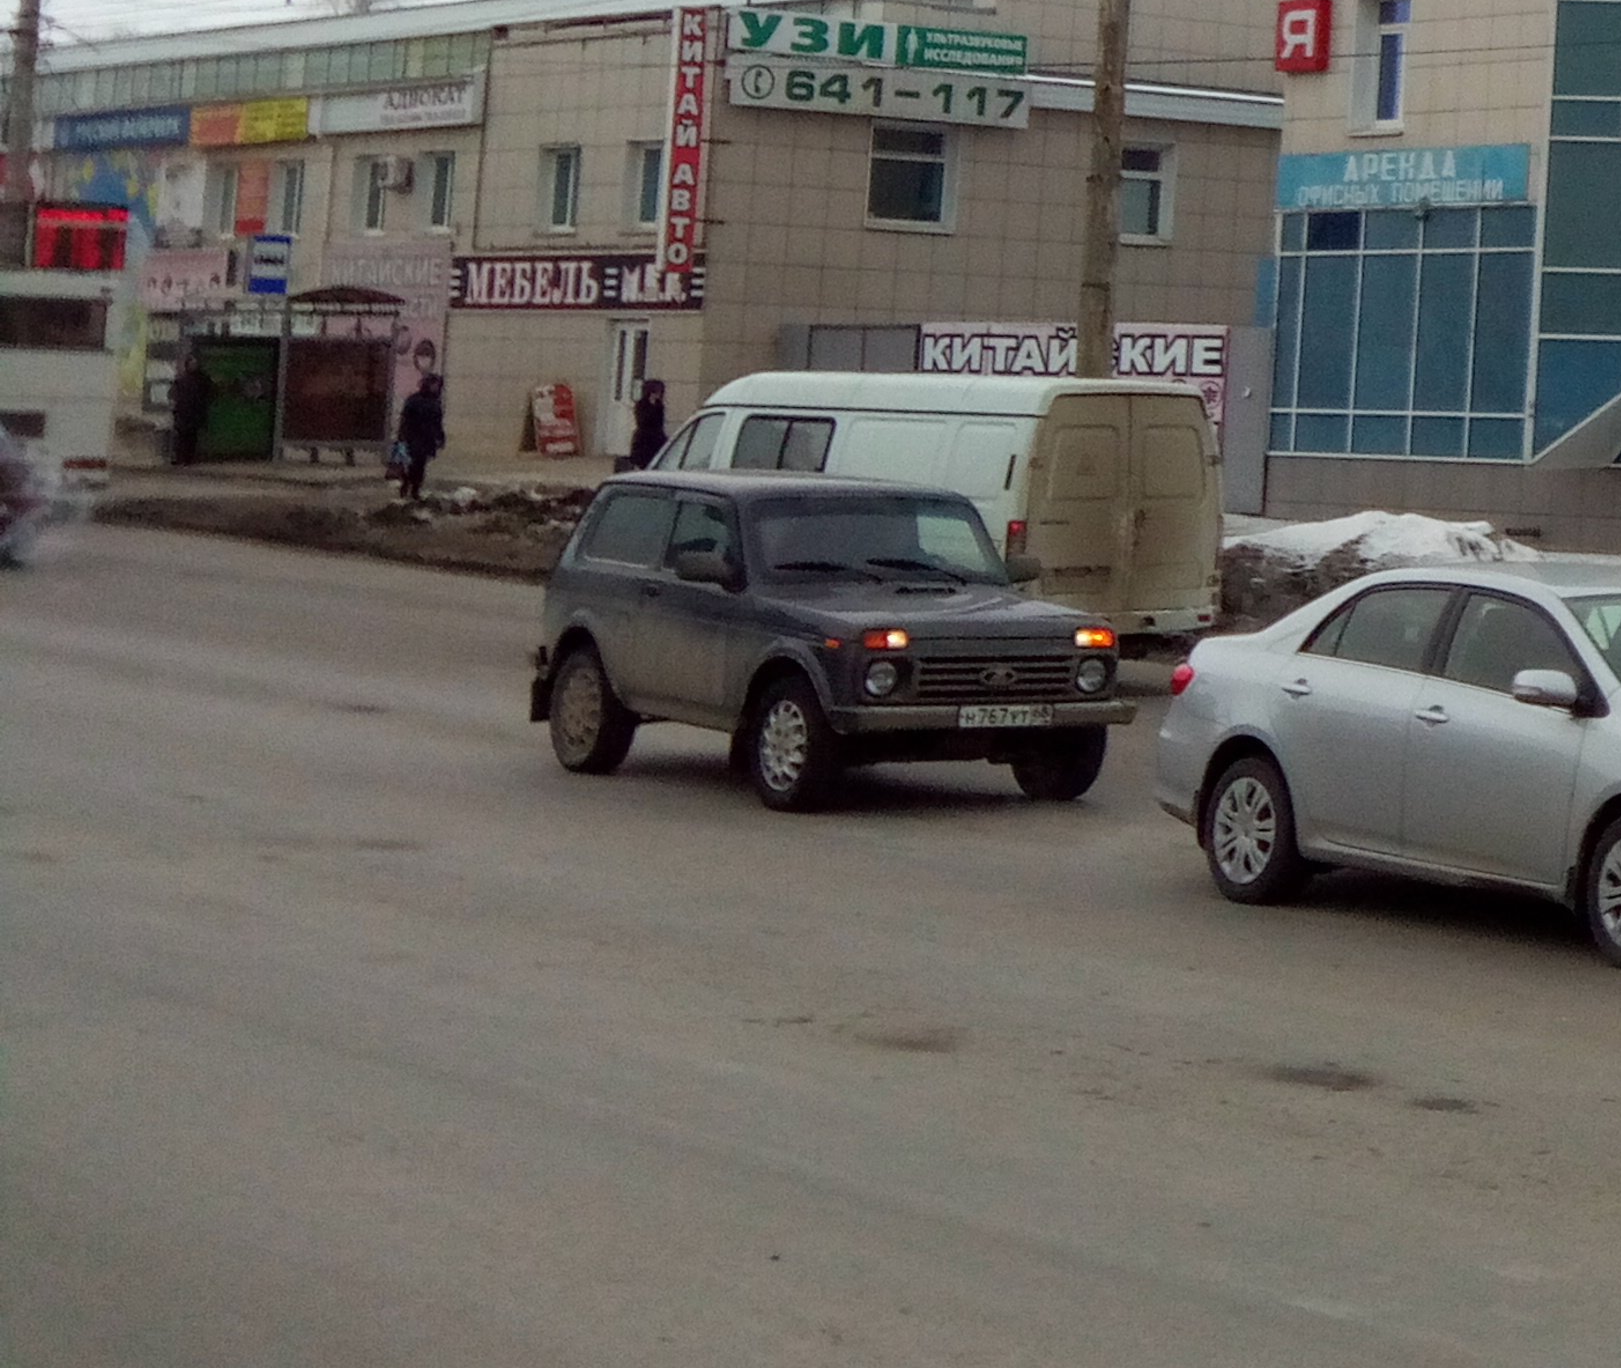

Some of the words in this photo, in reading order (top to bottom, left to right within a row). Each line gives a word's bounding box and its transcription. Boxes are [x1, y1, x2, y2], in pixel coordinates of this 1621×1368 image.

[738, 10, 885, 59] УЗИ
[675, 13, 703, 147] КИТАЙ
[785, 70, 1026, 118] 641-117
[1343, 149, 1456, 182] АРЕНДА
[667, 163, 695, 265] АВТО
[464, 261, 599, 305] МЕБЕЛЬ
[922, 328, 1224, 376] КИТАЙКИЕ
